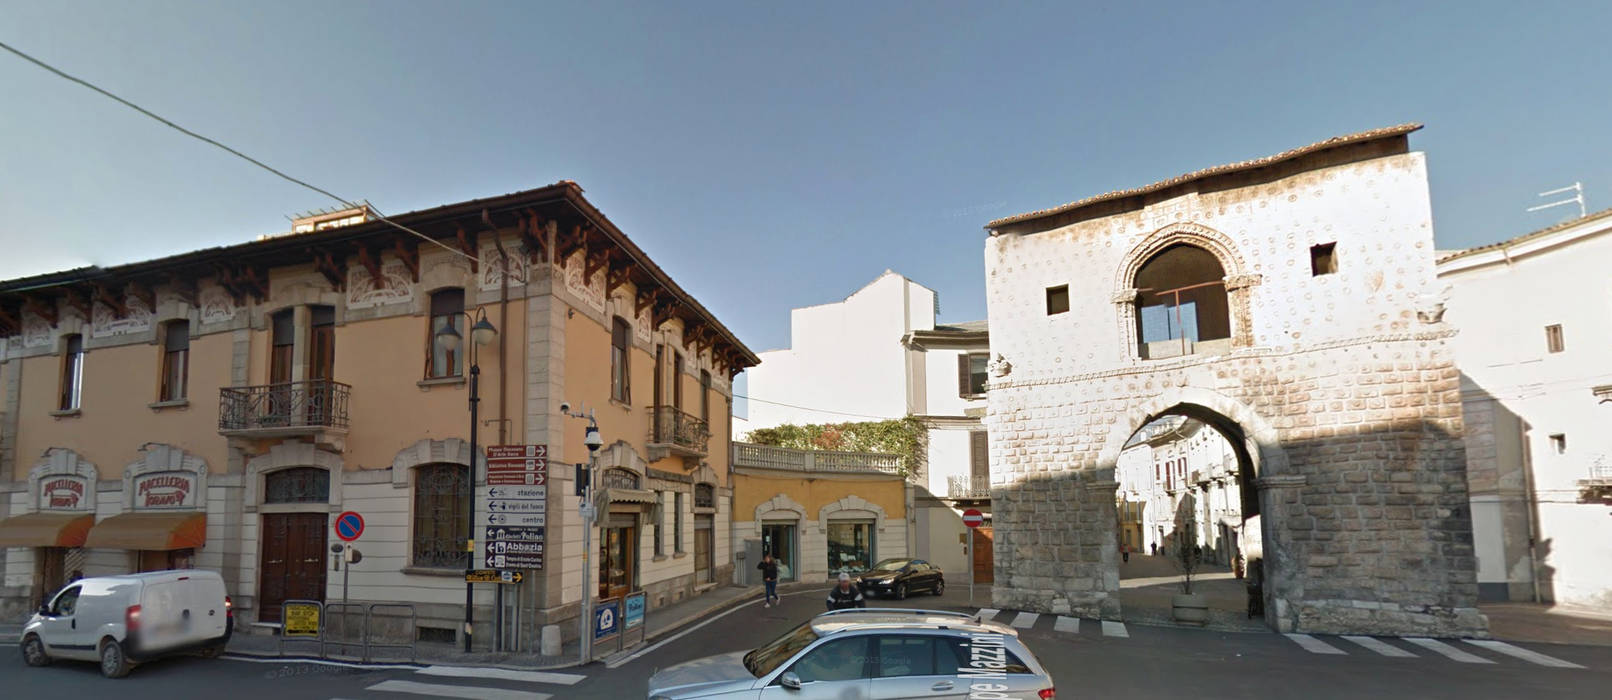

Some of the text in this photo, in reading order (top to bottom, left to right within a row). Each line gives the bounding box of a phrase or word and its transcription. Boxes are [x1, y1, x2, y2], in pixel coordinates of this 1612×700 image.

[138, 476, 189, 496] MACELLERIA
[517, 489, 544, 497] stazione
[506, 542, 543, 551] Abbazia
